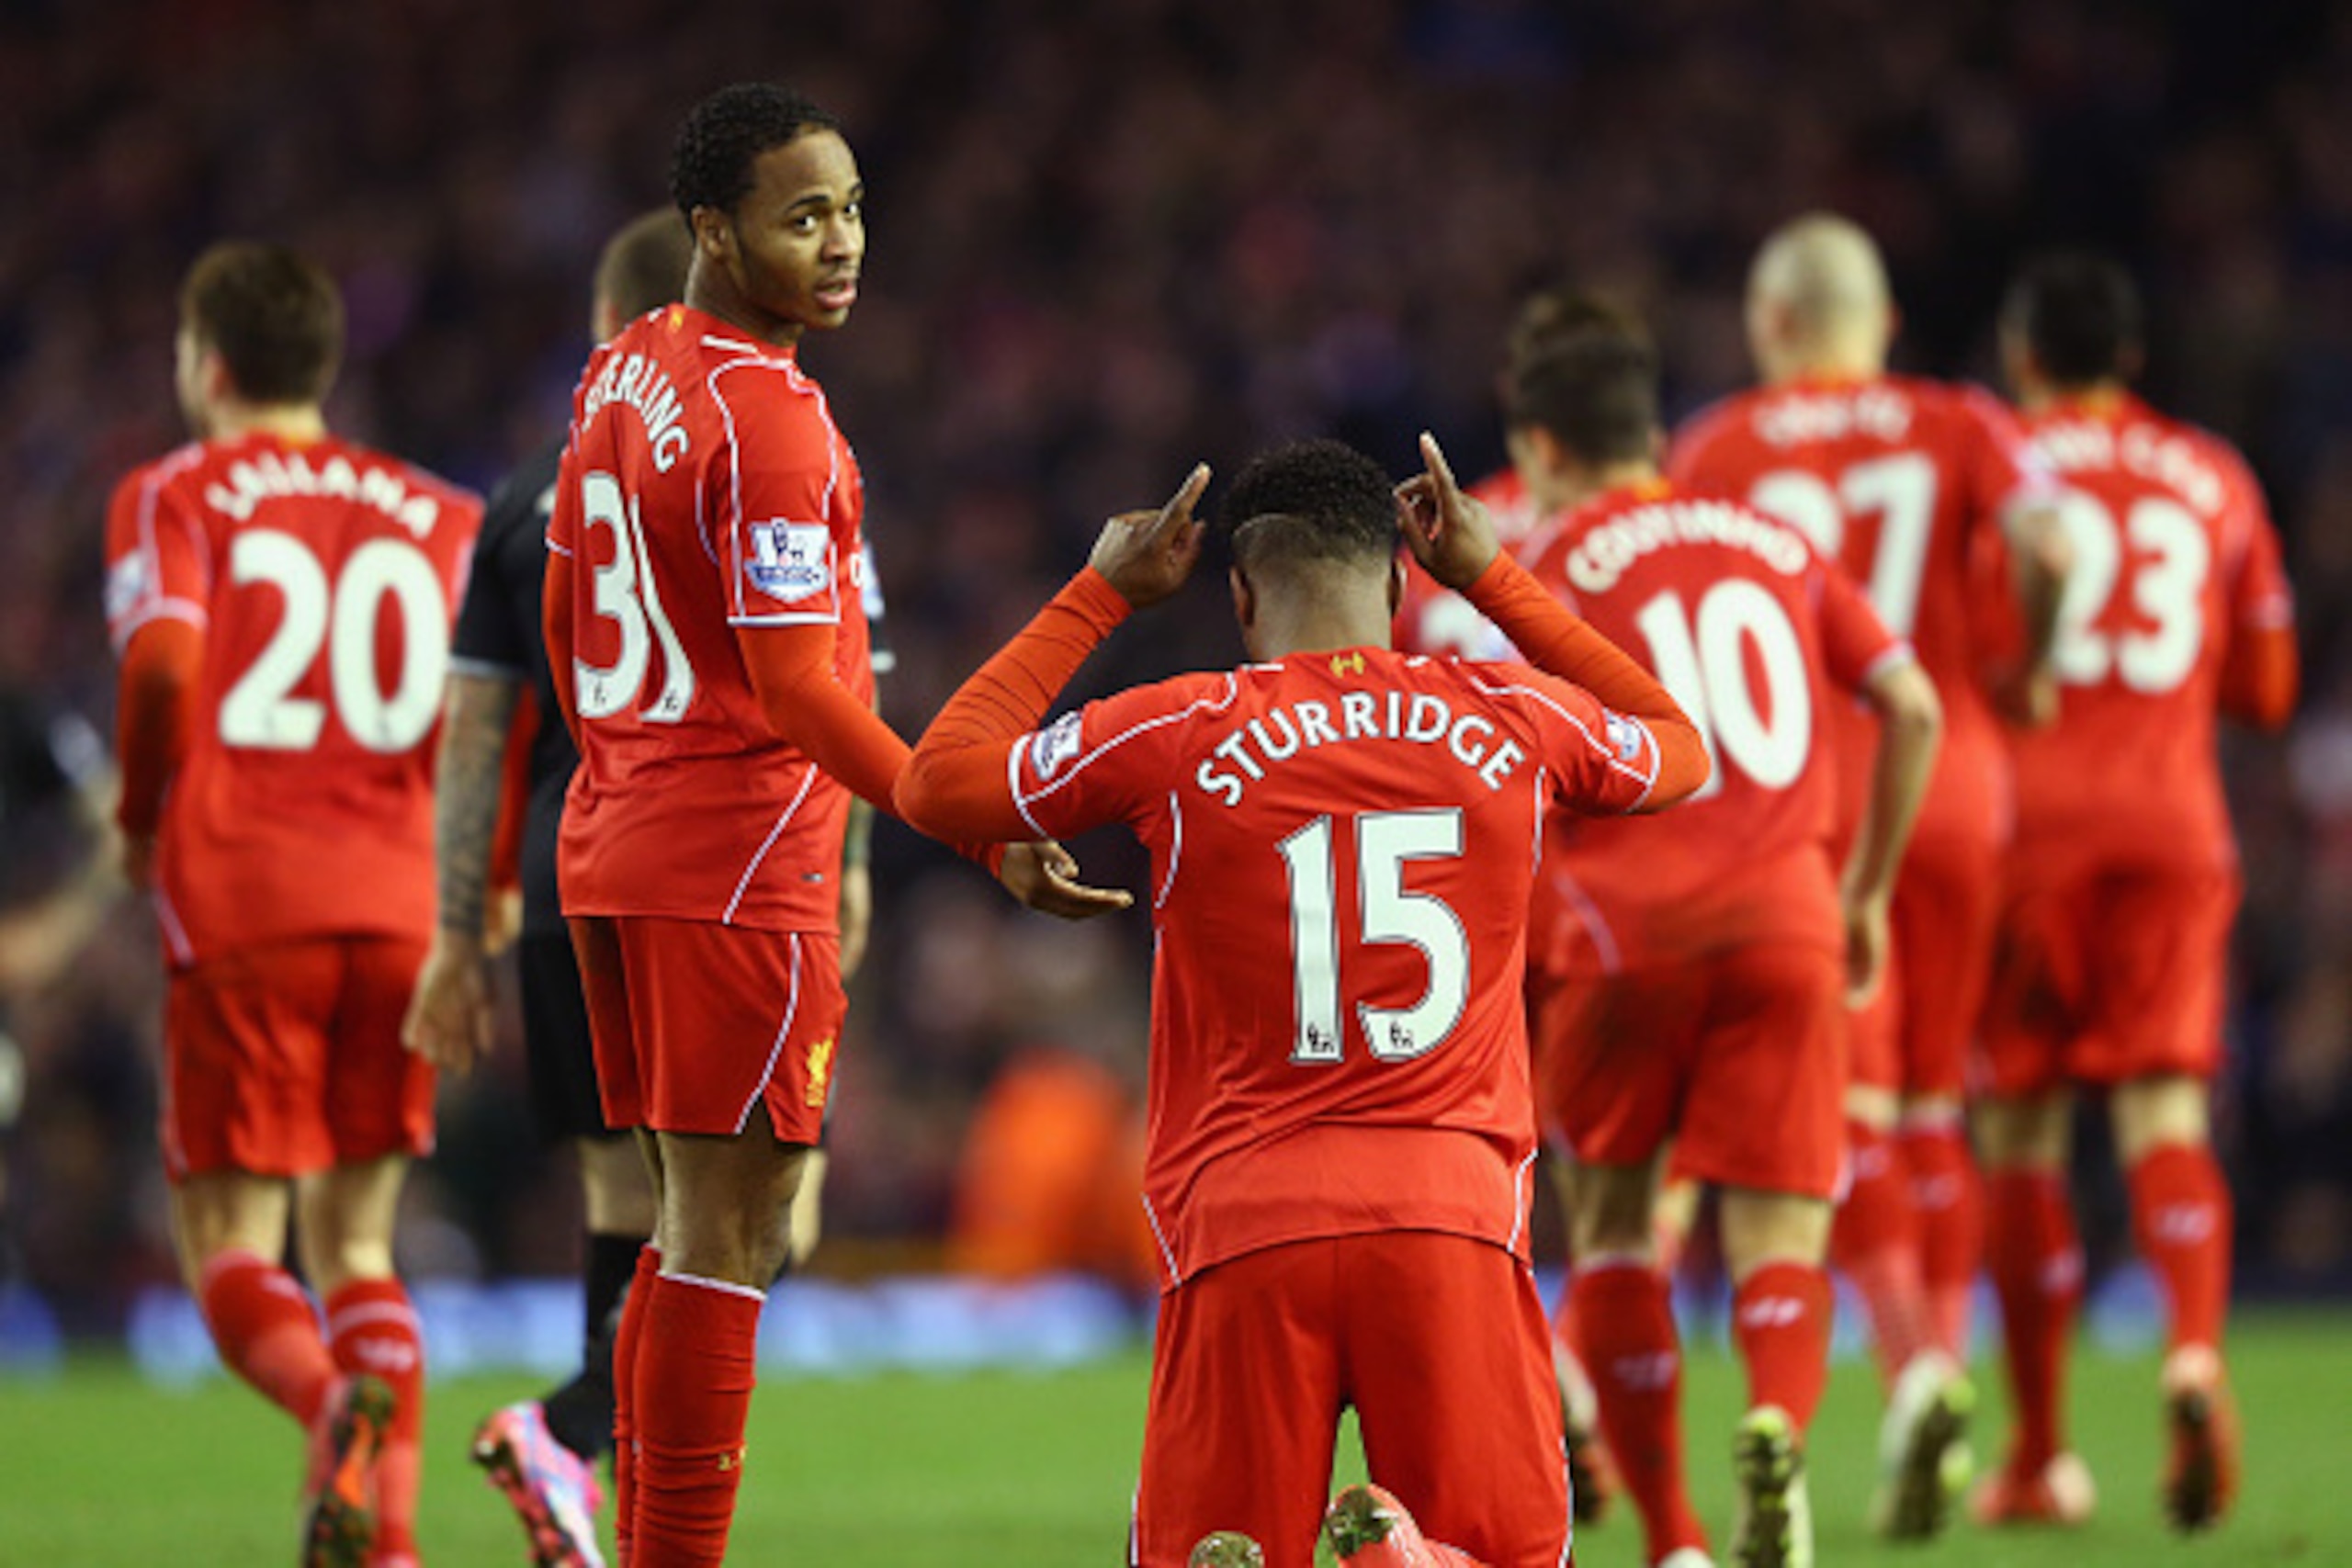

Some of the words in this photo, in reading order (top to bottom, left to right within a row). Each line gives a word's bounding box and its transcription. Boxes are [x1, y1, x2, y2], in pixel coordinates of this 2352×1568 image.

[205, 450, 440, 540] LALLANA
[582, 352, 690, 475] ERLING
[219, 528, 450, 752] 20
[573, 469, 695, 722] 31
[1566, 500, 1809, 593] COUTINHO
[2052, 484, 2210, 695] 23
[1196, 691, 1526, 806] STURRIDGE
[1637, 578, 1811, 801] 10
[1275, 807, 1469, 1063] 15
